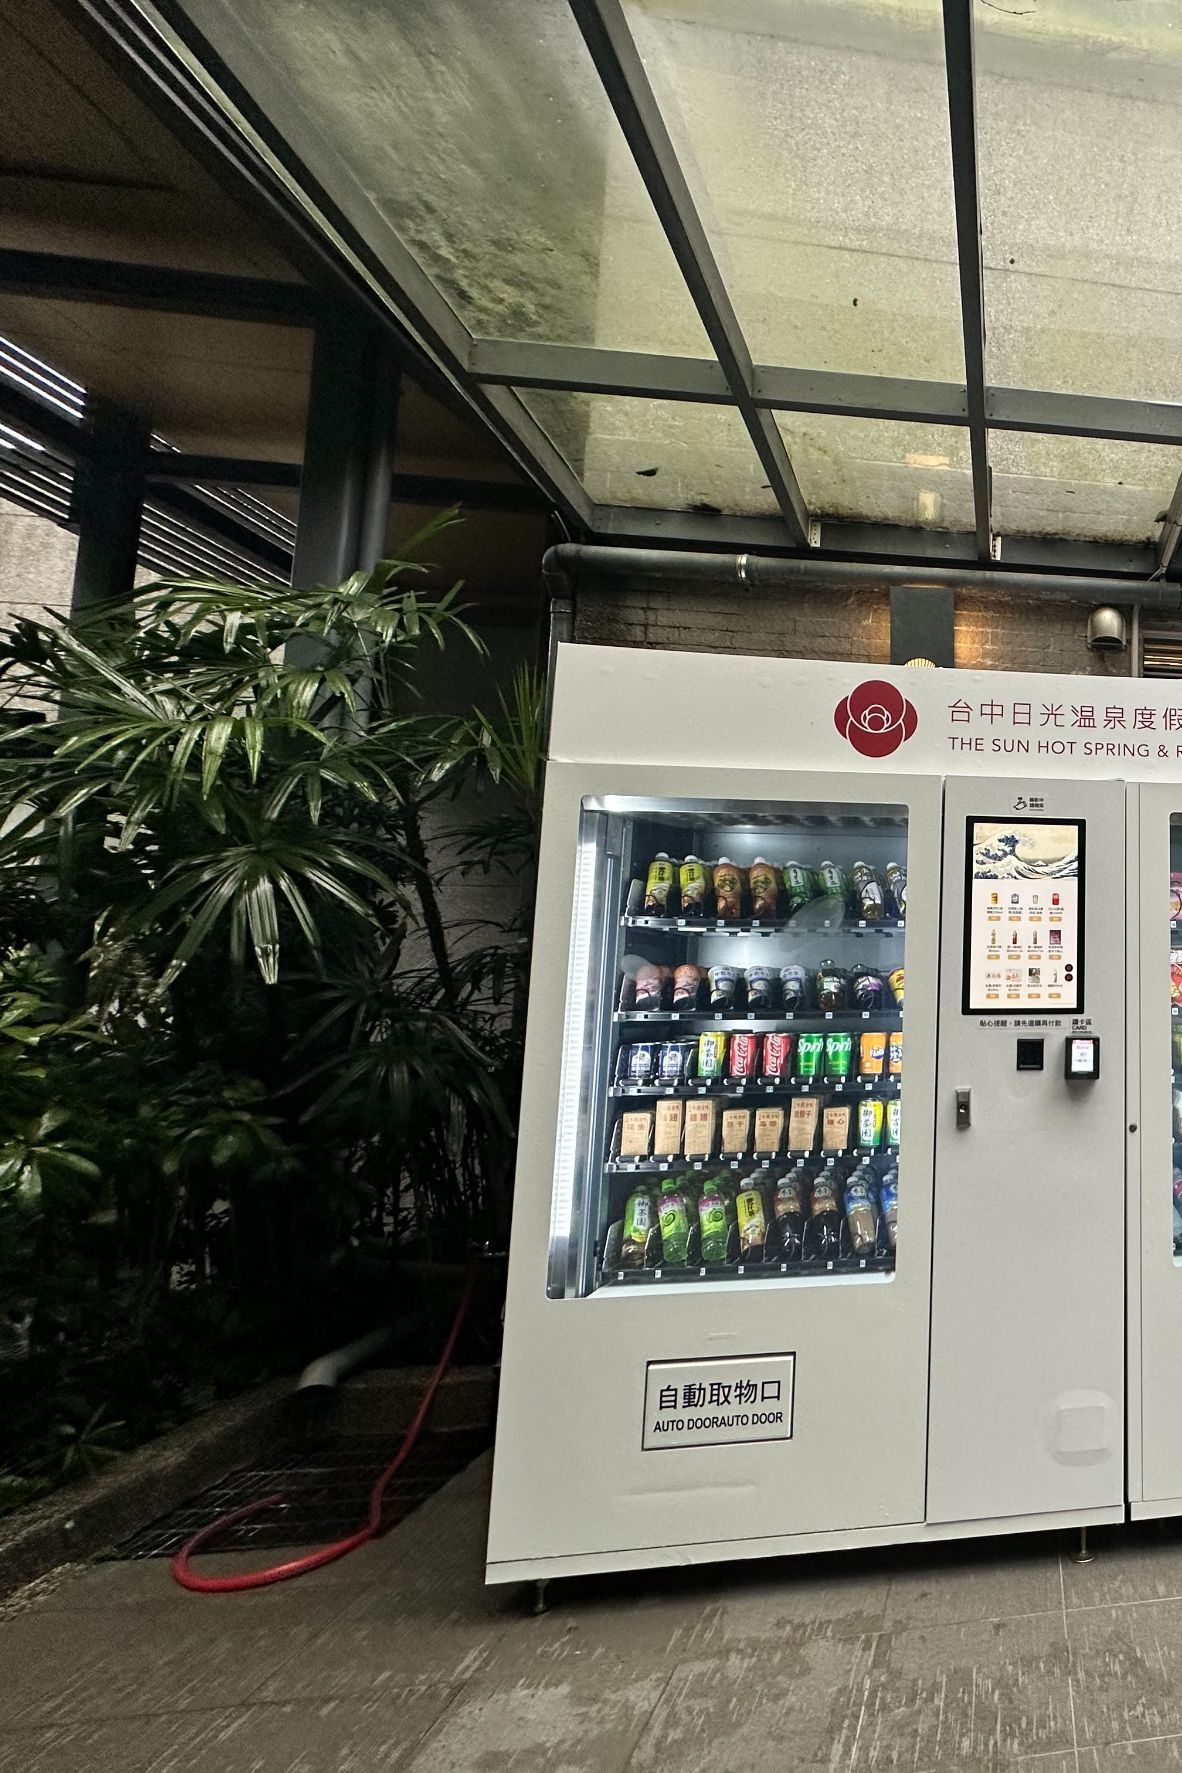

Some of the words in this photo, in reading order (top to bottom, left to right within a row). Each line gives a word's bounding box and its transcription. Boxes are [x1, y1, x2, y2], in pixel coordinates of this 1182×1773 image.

[947, 736, 985, 752] THE
[992, 738, 1030, 753] SUN
[1037, 740, 1077, 755] HOT
[1083, 741, 1150, 758] SPRING
[1156, 744, 1169, 758] &
[659, 1379, 781, 1410] 自動取物口
[653, 1419, 684, 1432] AUTO
[751, 1412, 783, 1425] DOOR
